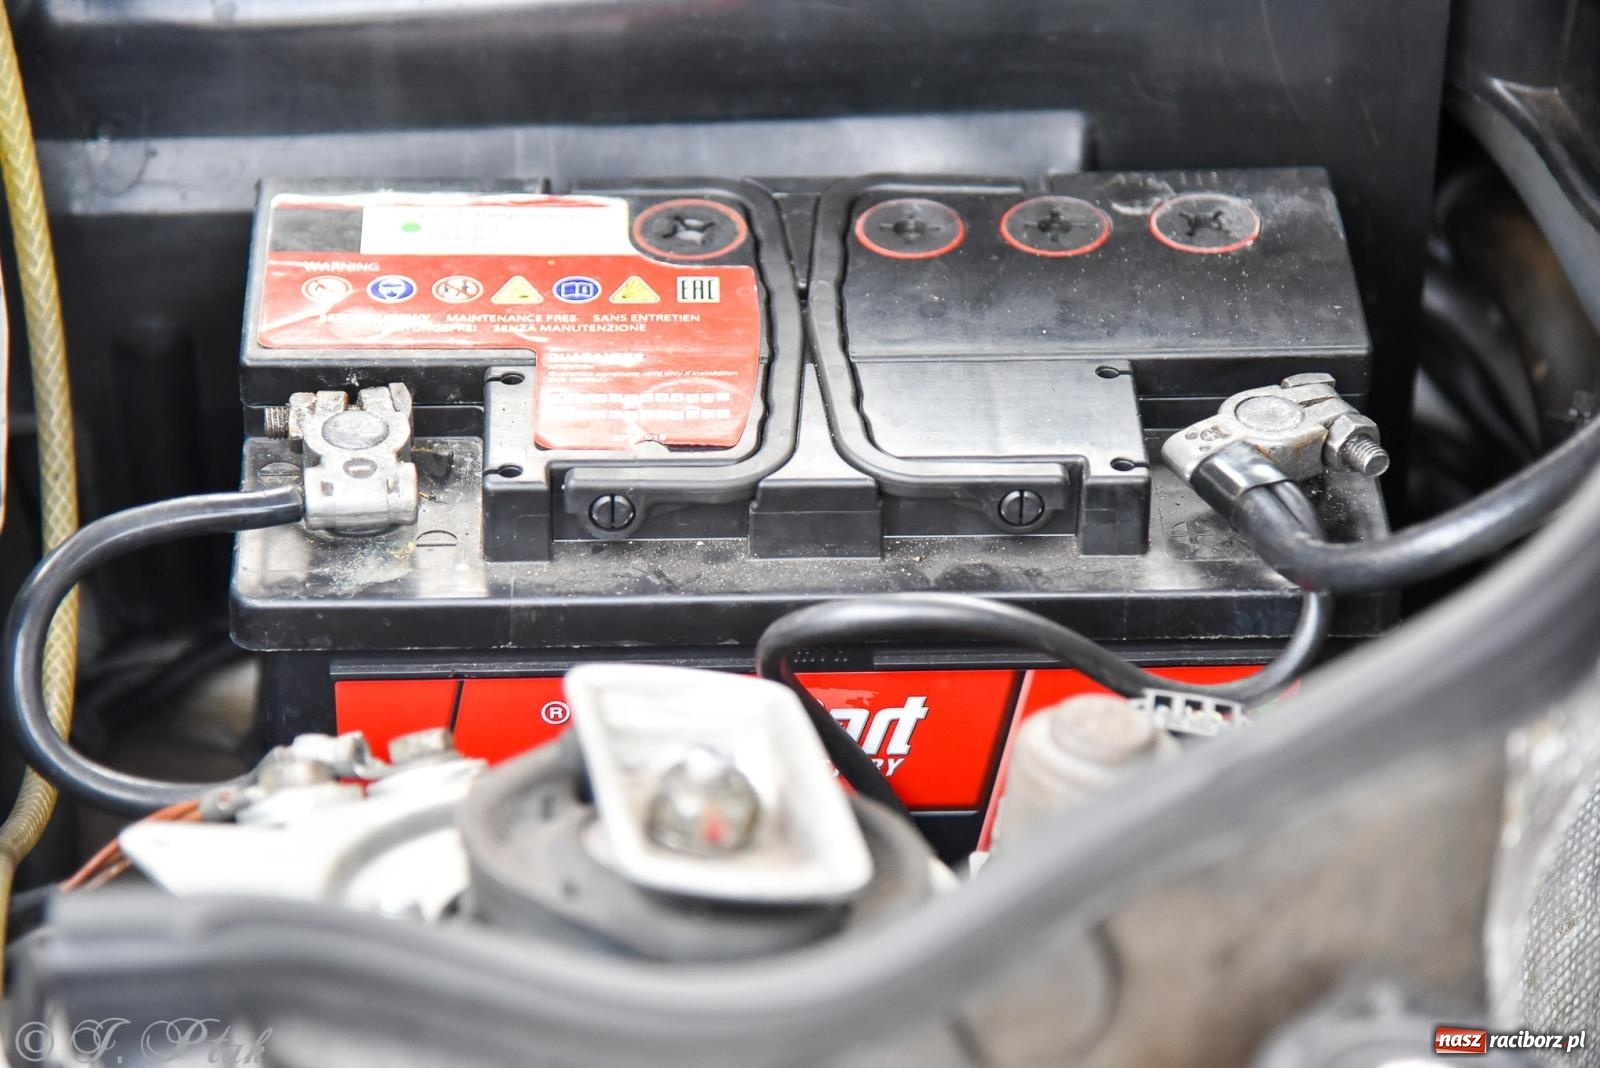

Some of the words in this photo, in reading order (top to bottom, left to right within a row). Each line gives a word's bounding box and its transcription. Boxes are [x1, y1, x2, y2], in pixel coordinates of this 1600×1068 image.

[304, 261, 381, 272] WARNING
[446, 313, 542, 323] MAINTENANCE
[546, 313, 577, 323] FREE
[592, 313, 627, 323] SANS
[630, 313, 701, 323] ENTRETIEN
[492, 323, 537, 333] SENZA
[540, 323, 647, 333] MANUTENZIONE
